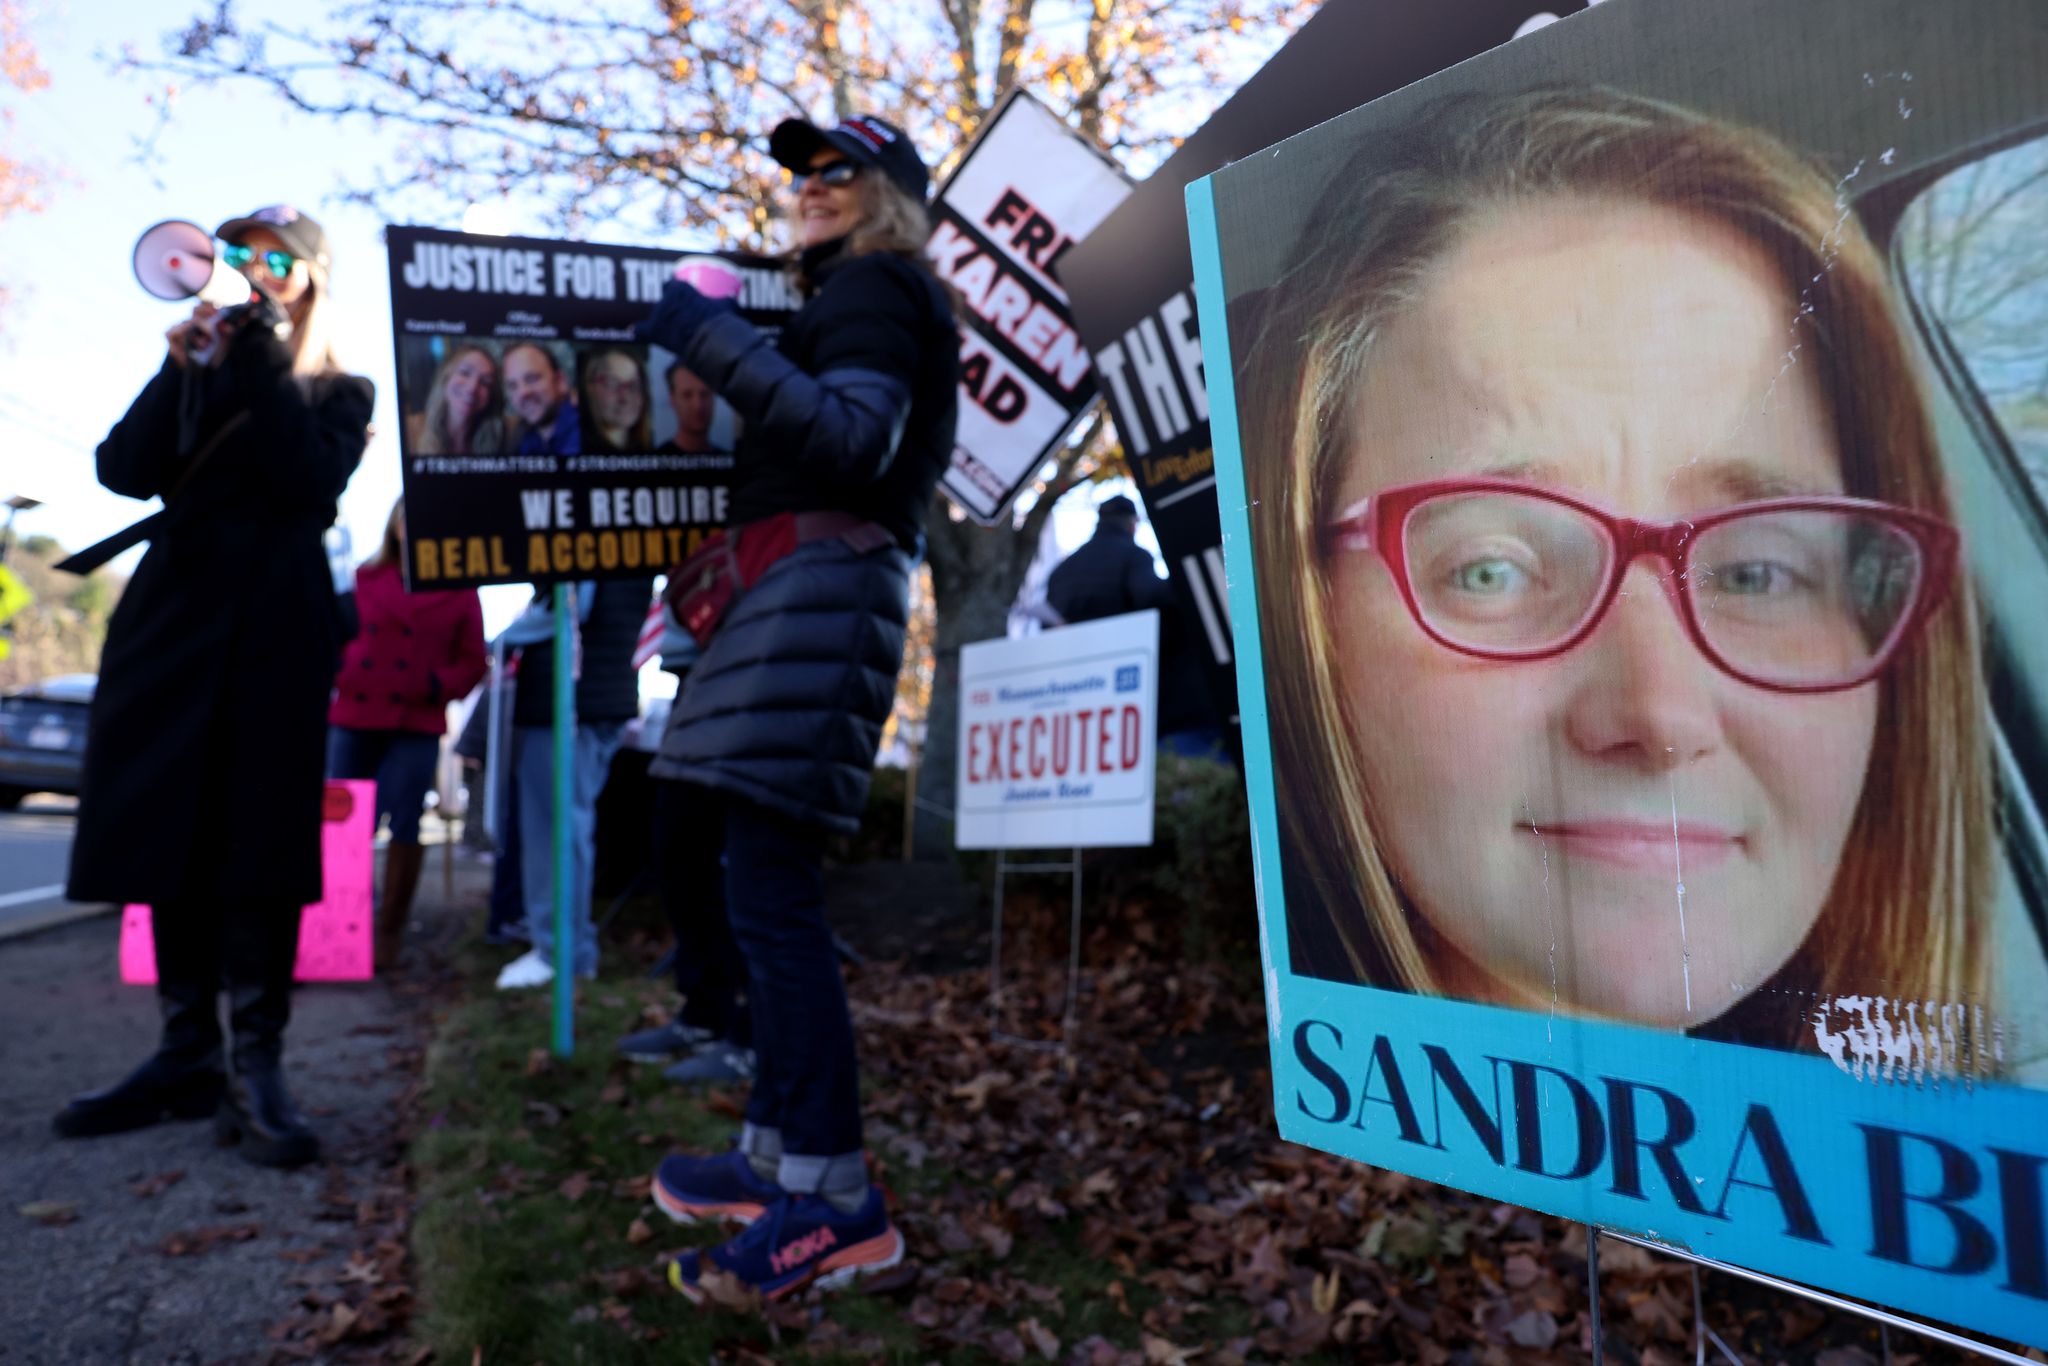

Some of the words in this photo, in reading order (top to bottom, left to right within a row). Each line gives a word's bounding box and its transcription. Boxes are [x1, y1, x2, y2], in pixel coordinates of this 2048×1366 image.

[404, 241, 546, 295] JUSTICE
[553, 252, 616, 300] FOR
[735, 266, 804, 311] TIMS
[924, 218, 1093, 392] KAREN
[958, 334, 1028, 424] AD
[1095, 281, 1213, 456] THE
[413, 456, 557, 474] #TRUTHMATTERS
[521, 489, 574, 529] WE
[590, 485, 729, 527] REQUIRE
[416, 536, 511, 580] REAL
[528, 528, 724, 574] ACCOUNTA
[967, 704, 1141, 785] EXECUTED
[1293, 1018, 1833, 1250] SANDRA
[770, 1226, 837, 1275] HOKA
